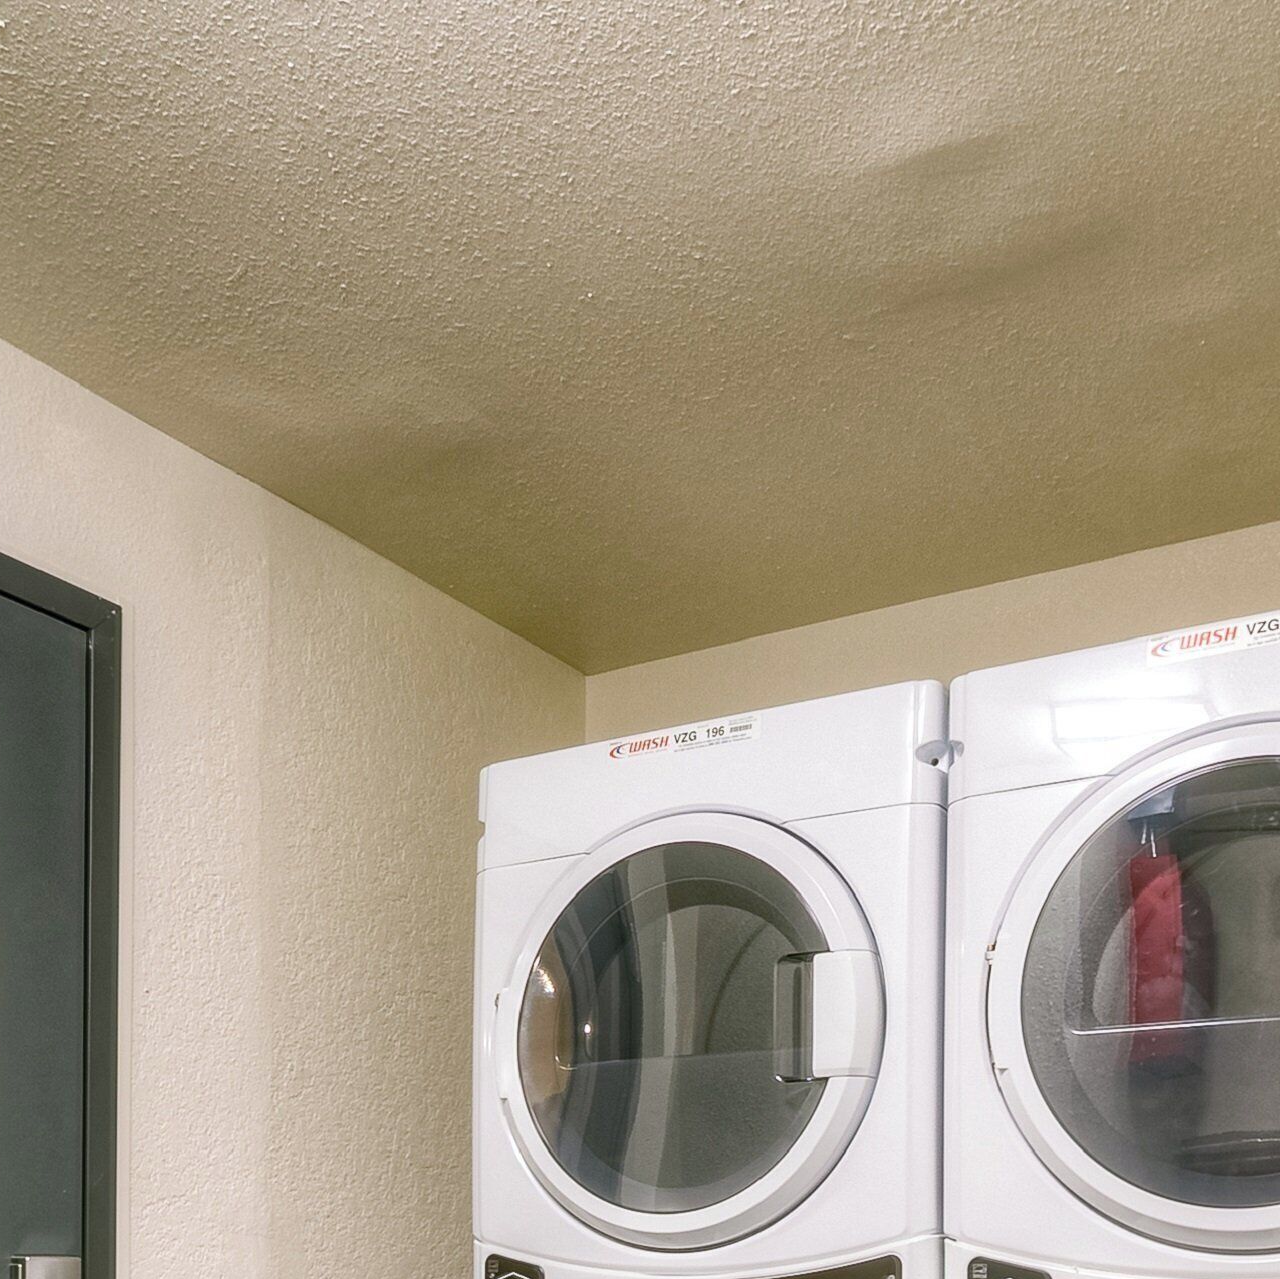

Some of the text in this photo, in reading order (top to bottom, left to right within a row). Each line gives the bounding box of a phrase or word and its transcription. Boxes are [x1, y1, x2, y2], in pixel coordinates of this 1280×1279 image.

[1179, 625, 1238, 650] WASH
[1246, 618, 1280, 636] VZG
[628, 735, 670, 754] WASH
[673, 730, 697, 744] VZG
[705, 726, 725, 739] 196
